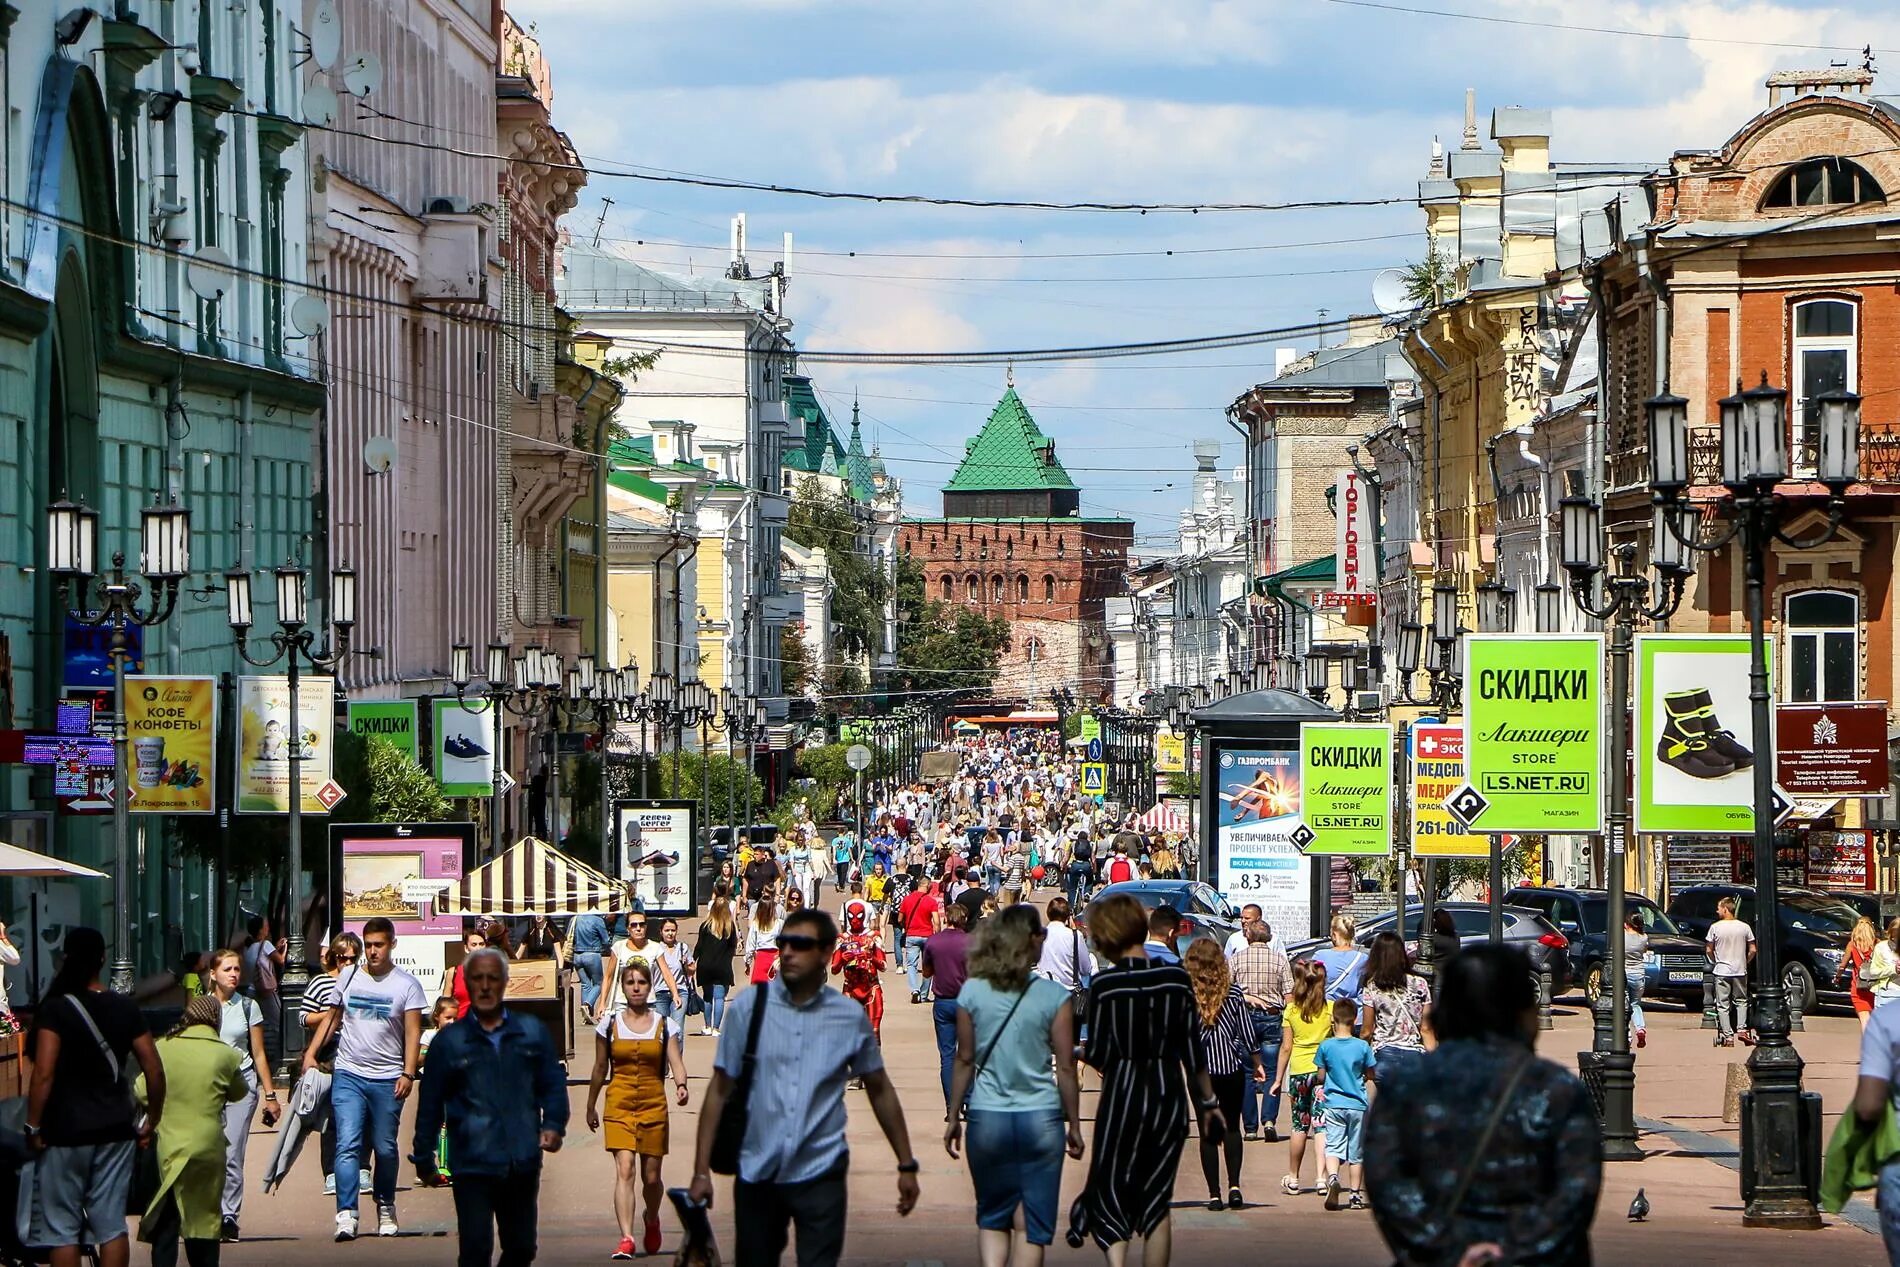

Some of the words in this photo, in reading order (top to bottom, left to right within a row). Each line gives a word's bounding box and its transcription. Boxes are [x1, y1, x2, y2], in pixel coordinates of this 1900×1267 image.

[1345, 474, 1358, 592] ТОРГОВЫЙ
[1480, 669, 1588, 703] СКИДКИ
[147, 707, 185, 718] КОФЕ
[134, 719, 201, 731] КОНФЕТЫ
[356, 717, 410, 735] СКИДКИ
[1478, 722, 1590, 748] Лакшери
[1237, 757, 1290, 766] ГАЗПРОМБАНК
[1311, 746, 1382, 769] СКИДКИ
[1512, 753, 1557, 764] STORE
[1486, 776, 1585, 790] LS.NET.RU
[1310, 782, 1383, 799] Лакшери
[1331, 802, 1361, 810] STORE
[1315, 818, 1380, 828] LS.NET.RU
[1230, 844, 1266, 854] ПРОЦЕНТ
